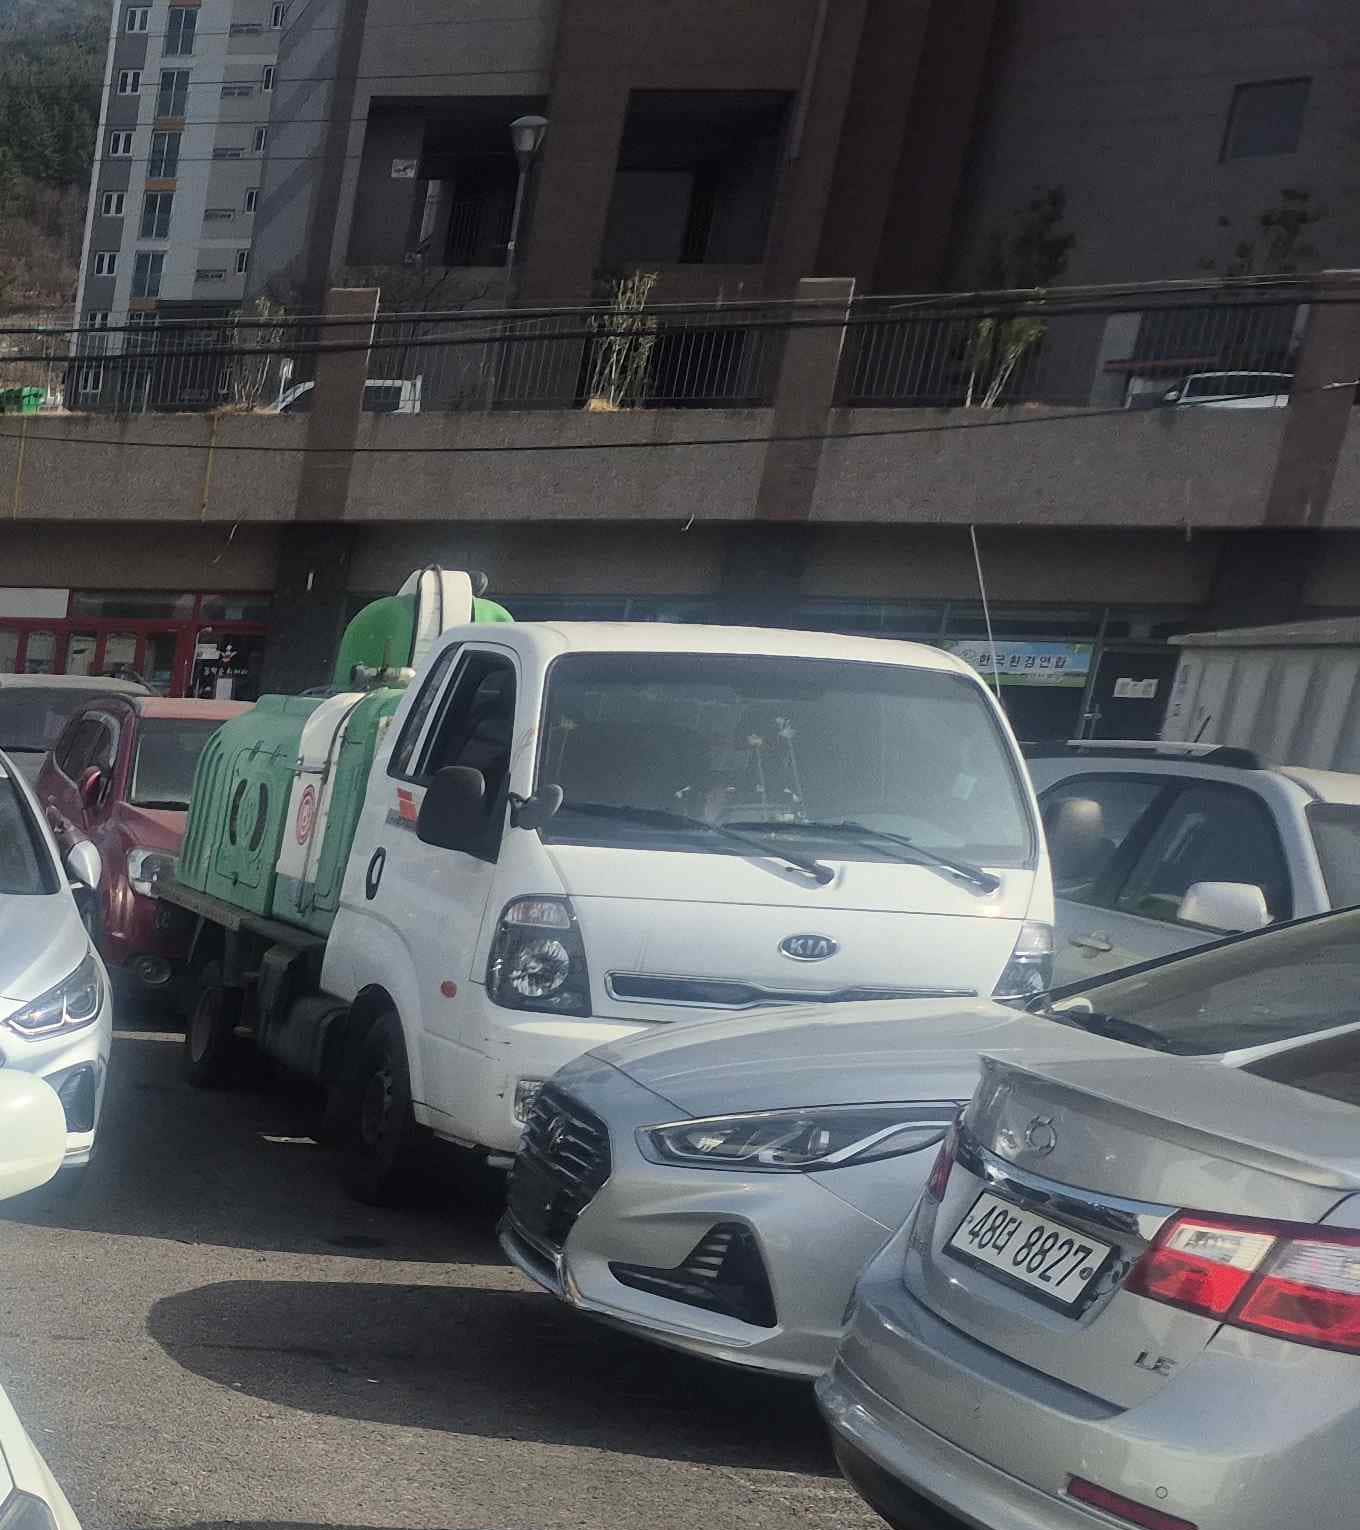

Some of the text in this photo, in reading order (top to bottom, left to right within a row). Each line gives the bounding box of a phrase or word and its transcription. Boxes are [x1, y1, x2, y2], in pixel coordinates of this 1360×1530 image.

[790, 939, 828, 954] KIA
[967, 1204, 1095, 1288] 48더 8827
